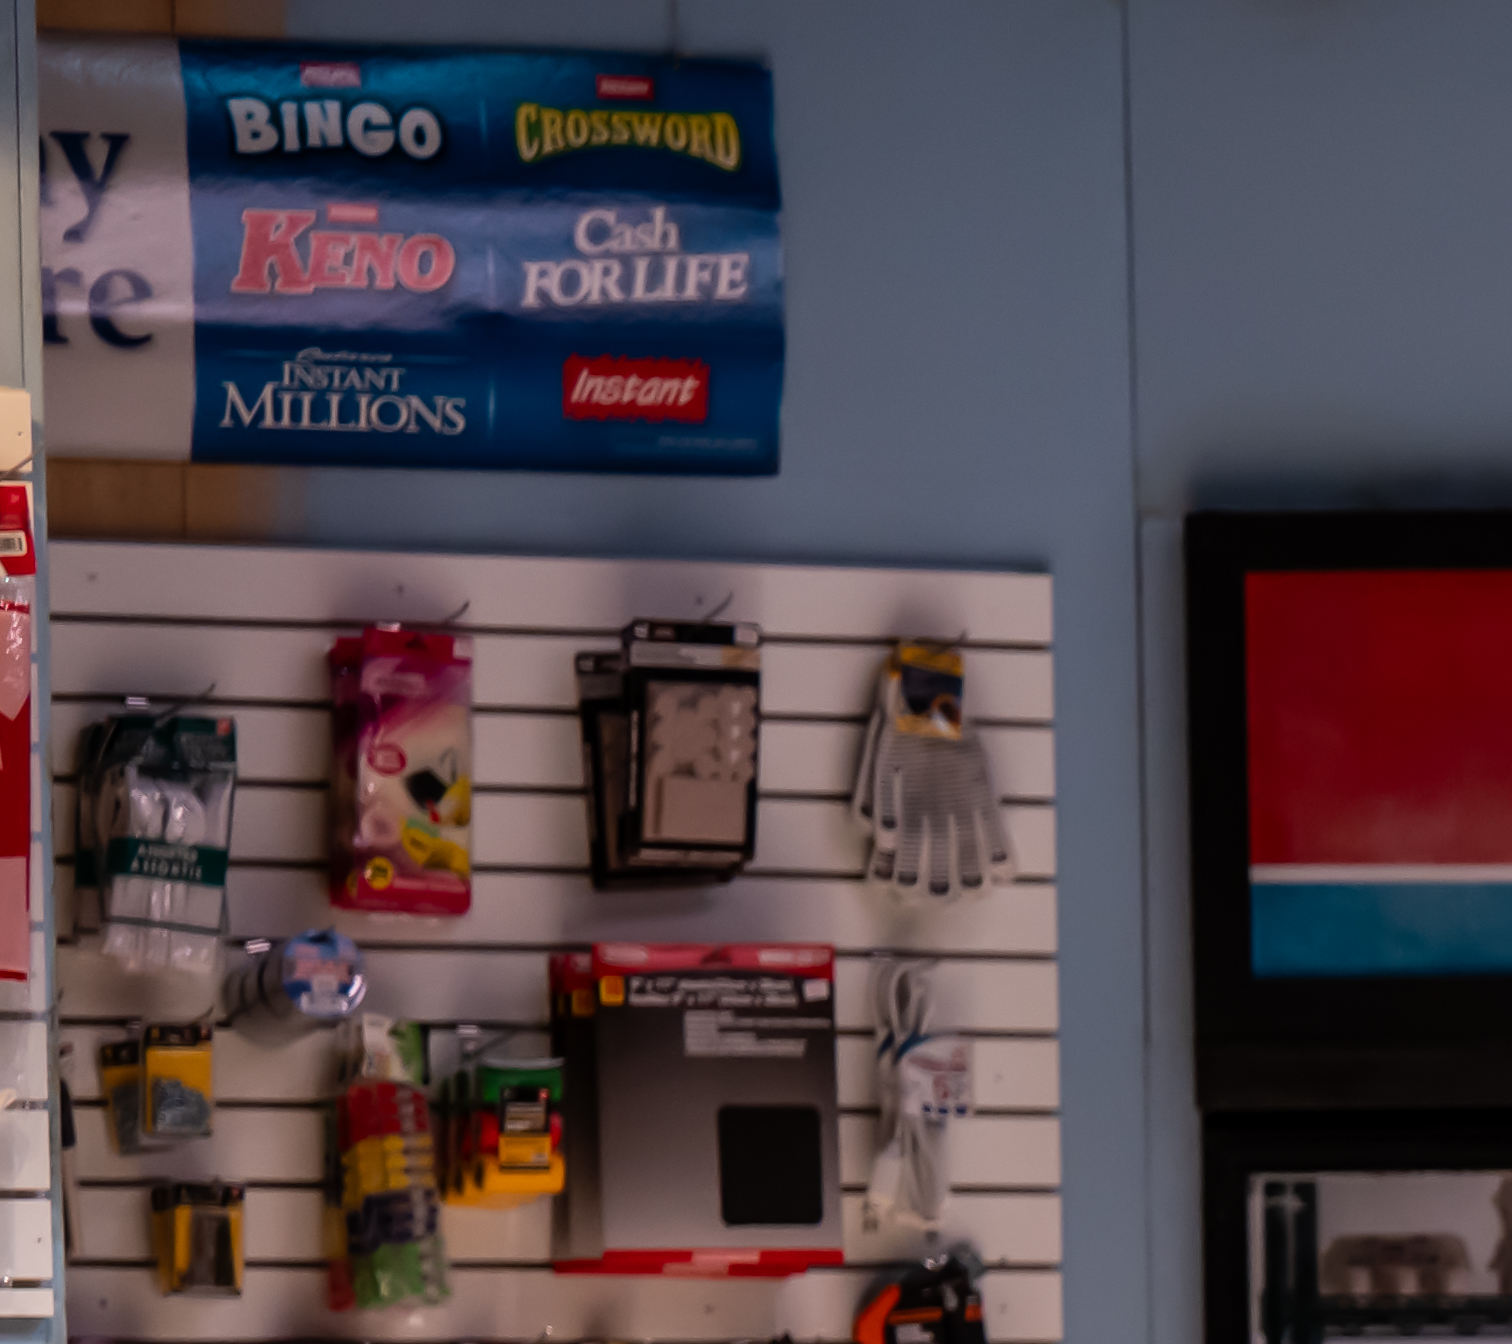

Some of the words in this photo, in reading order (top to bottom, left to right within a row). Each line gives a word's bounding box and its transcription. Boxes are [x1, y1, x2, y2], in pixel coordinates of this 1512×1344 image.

[227, 98, 442, 160] BINGO
[515, 103, 742, 173] CROSSWORD
[231, 208, 457, 295] KENO
[574, 205, 681, 255] Cash
[521, 258, 624, 309] FOR
[632, 252, 750, 303] LIFE
[282, 361, 407, 392] INSTANT
[570, 367, 700, 408] Instant
[219, 380, 467, 435] MILLIONS
